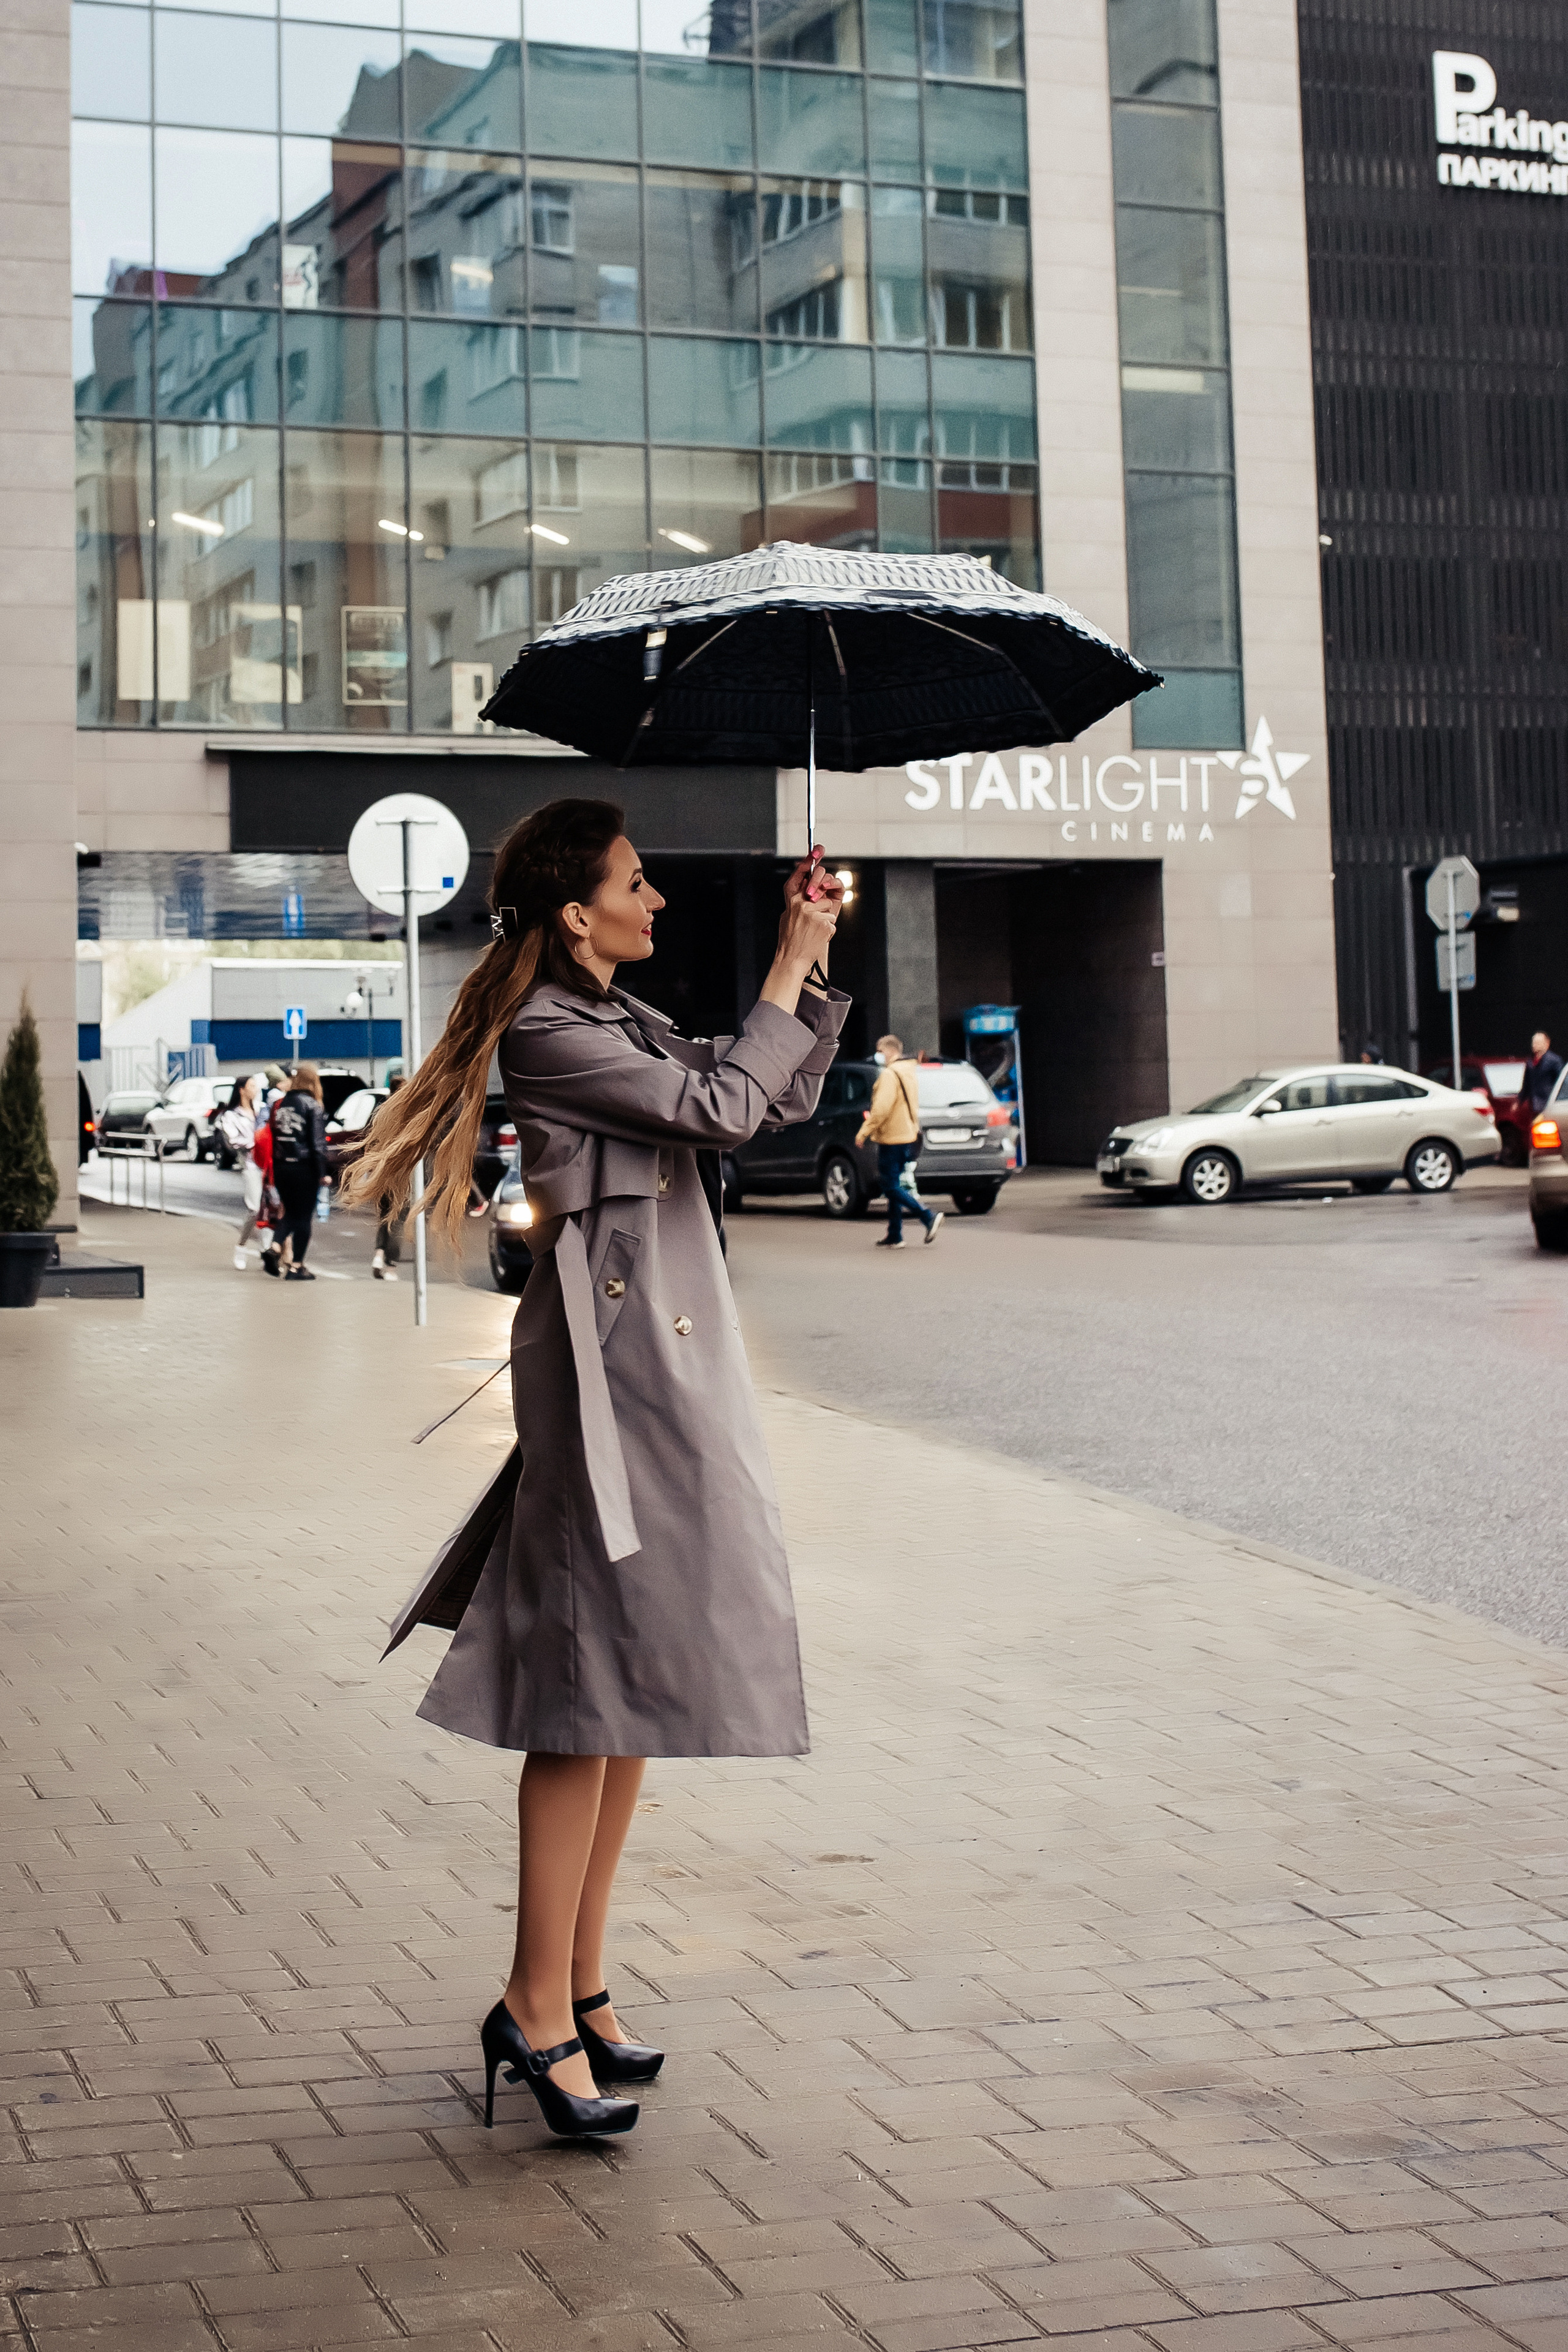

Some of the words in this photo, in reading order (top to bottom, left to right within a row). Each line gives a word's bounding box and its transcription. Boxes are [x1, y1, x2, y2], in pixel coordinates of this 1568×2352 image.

[1432, 50, 1568, 164] Parking
[904, 753, 1219, 813] STARLIGHT
[1061, 820, 1215, 843] CINEMA
